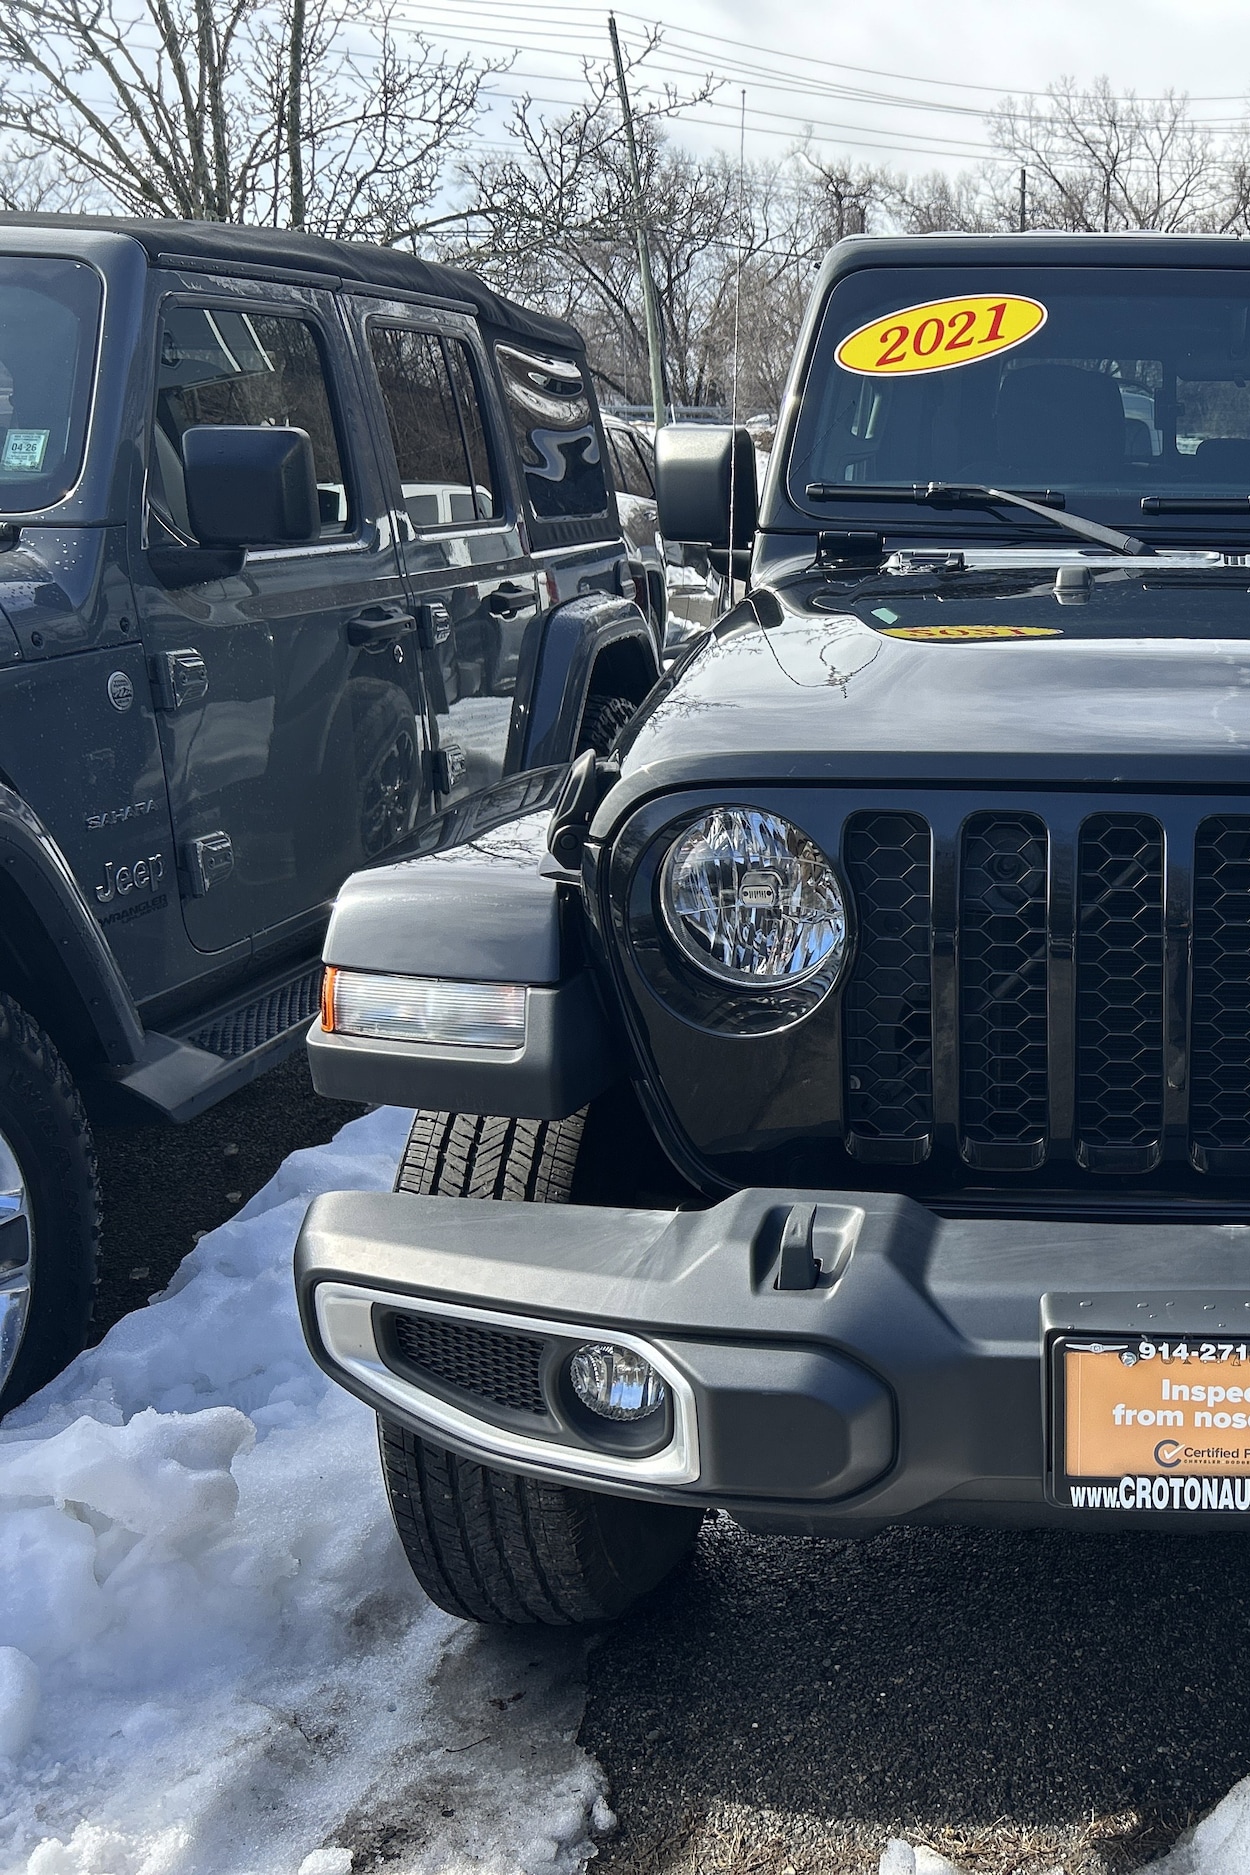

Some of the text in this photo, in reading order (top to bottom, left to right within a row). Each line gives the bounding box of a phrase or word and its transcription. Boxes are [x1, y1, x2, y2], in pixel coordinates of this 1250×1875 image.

[875, 302, 1008, 367] 2021
[86, 800, 160, 830] SAHARA
[96, 853, 165, 903] Jeep
[98, 894, 167, 926] WRANGLER
[1112, 1403, 1185, 1427] from
[1184, 1447, 1240, 1458] Certified
